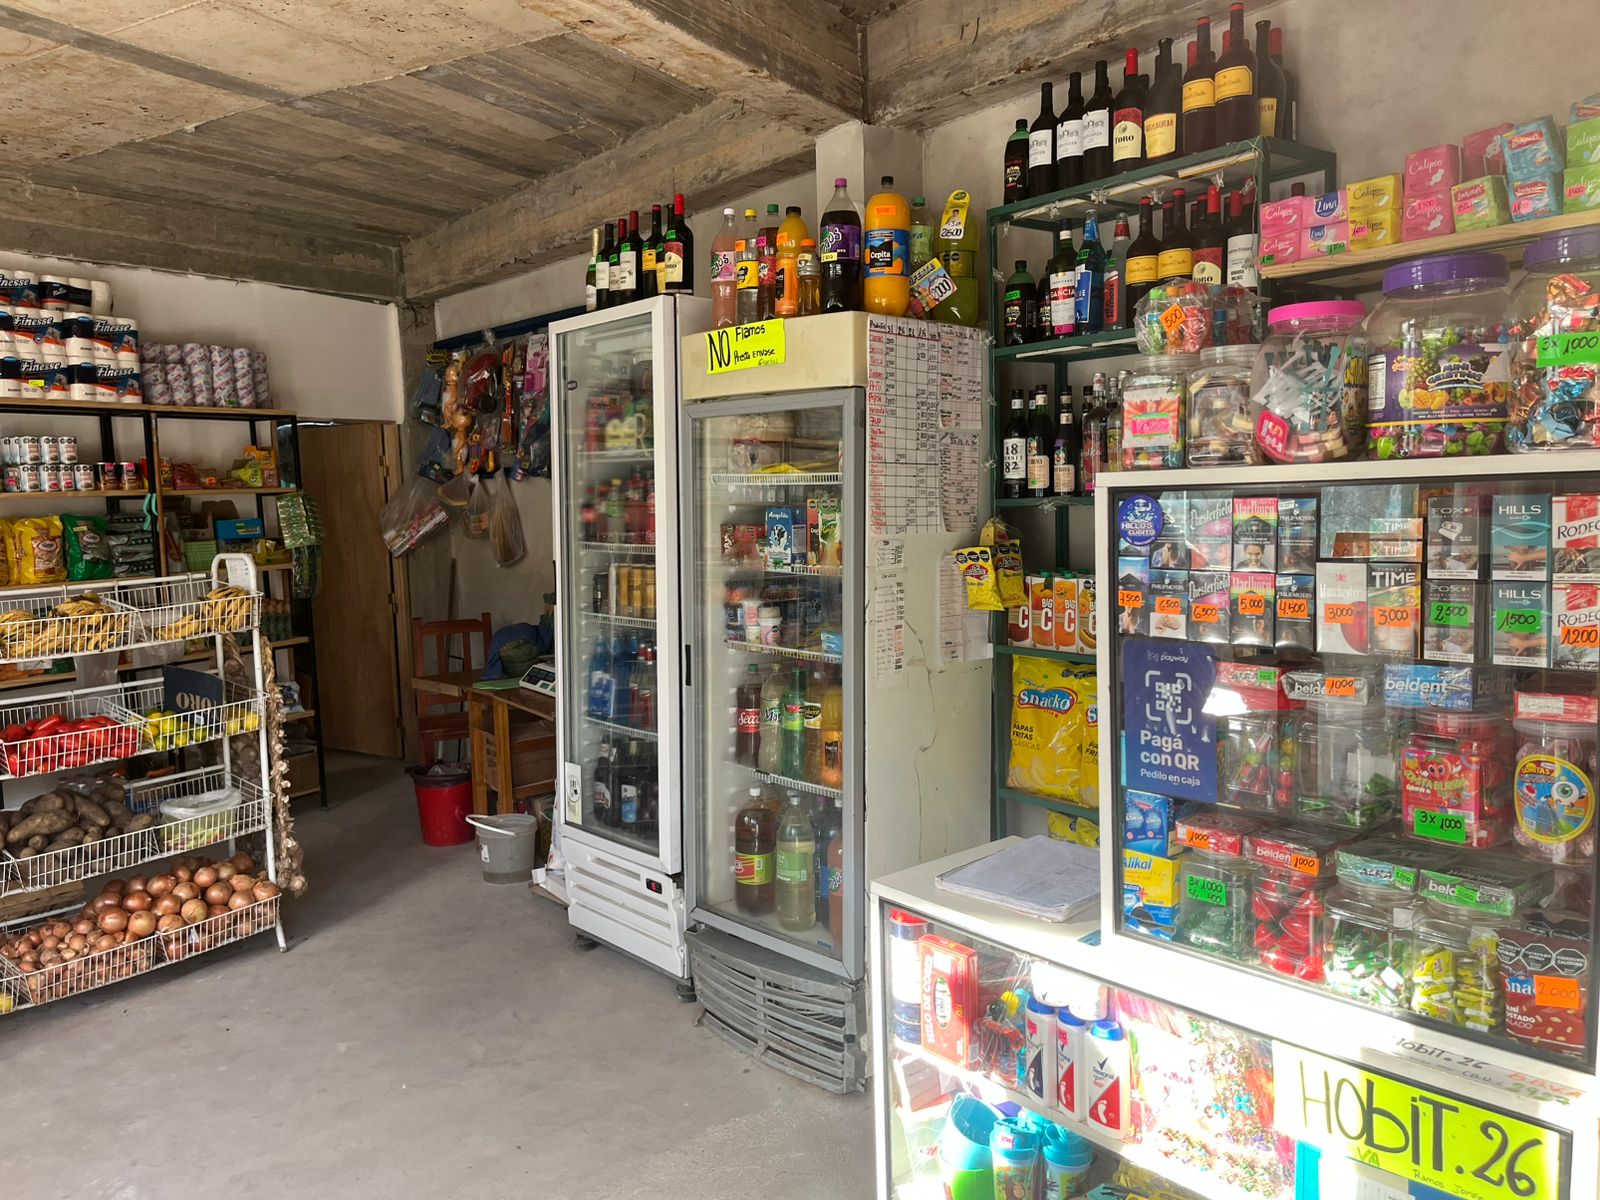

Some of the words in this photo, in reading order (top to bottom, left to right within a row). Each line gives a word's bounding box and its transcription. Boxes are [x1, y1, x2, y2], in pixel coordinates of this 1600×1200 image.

[1115, 135, 1134, 144] TORO
[1409, 159, 1442, 175] Calipso
[1354, 186, 1385, 200] Calipso
[1317, 201, 1337, 212] Lina
[871, 251, 891, 260] Cepita
[14, 314, 53, 327] Finesse
[1165, 308, 1183, 327] 500
[94, 320, 131, 333] Finesse
[708, 330, 730, 371] NO
[21, 359, 61, 372] Finesse
[97, 364, 133, 378] Finesse
[1005, 443, 1019, 456] 18
[1005, 461, 1020, 473] 82
[1235, 501, 1276, 519] Marlboro
[1432, 507, 1463, 515] FOX
[1498, 505, 1541, 515] HILLS
[1121, 522, 1153, 530] HIELOS
[1233, 576, 1272, 590] Marlboro
[1372, 572, 1415, 588] TIME
[1188, 573, 1230, 602] Chesterfield
[1498, 589, 1541, 599] HILLS
[1042, 599, 1053, 608] BIG
[1065, 600, 1076, 609] BIG
[1041, 608, 1052, 631] C
[1064, 609, 1075, 633] C
[1378, 608, 1409, 626] 3.000
[1434, 605, 1467, 623] 2.500
[1160, 654, 1189, 664] payway
[1294, 682, 1327, 695] belde
[1384, 677, 1448, 694] beldent
[1140, 729, 1183, 752] Pagá
[1140, 751, 1172, 766] con
[1174, 752, 1200, 772] QR
[1140, 768, 1168, 782] Pedilo
[1168, 775, 1180, 784] en
[1180, 776, 1201, 787] caja
[1256, 846, 1291, 862] belden
[1506, 1012, 1536, 1024] OSTADO
[1506, 1019, 1533, 1030] ALADO
[1357, 1146, 1380, 1168] VA
[1412, 1168, 1446, 1189] Ramos
